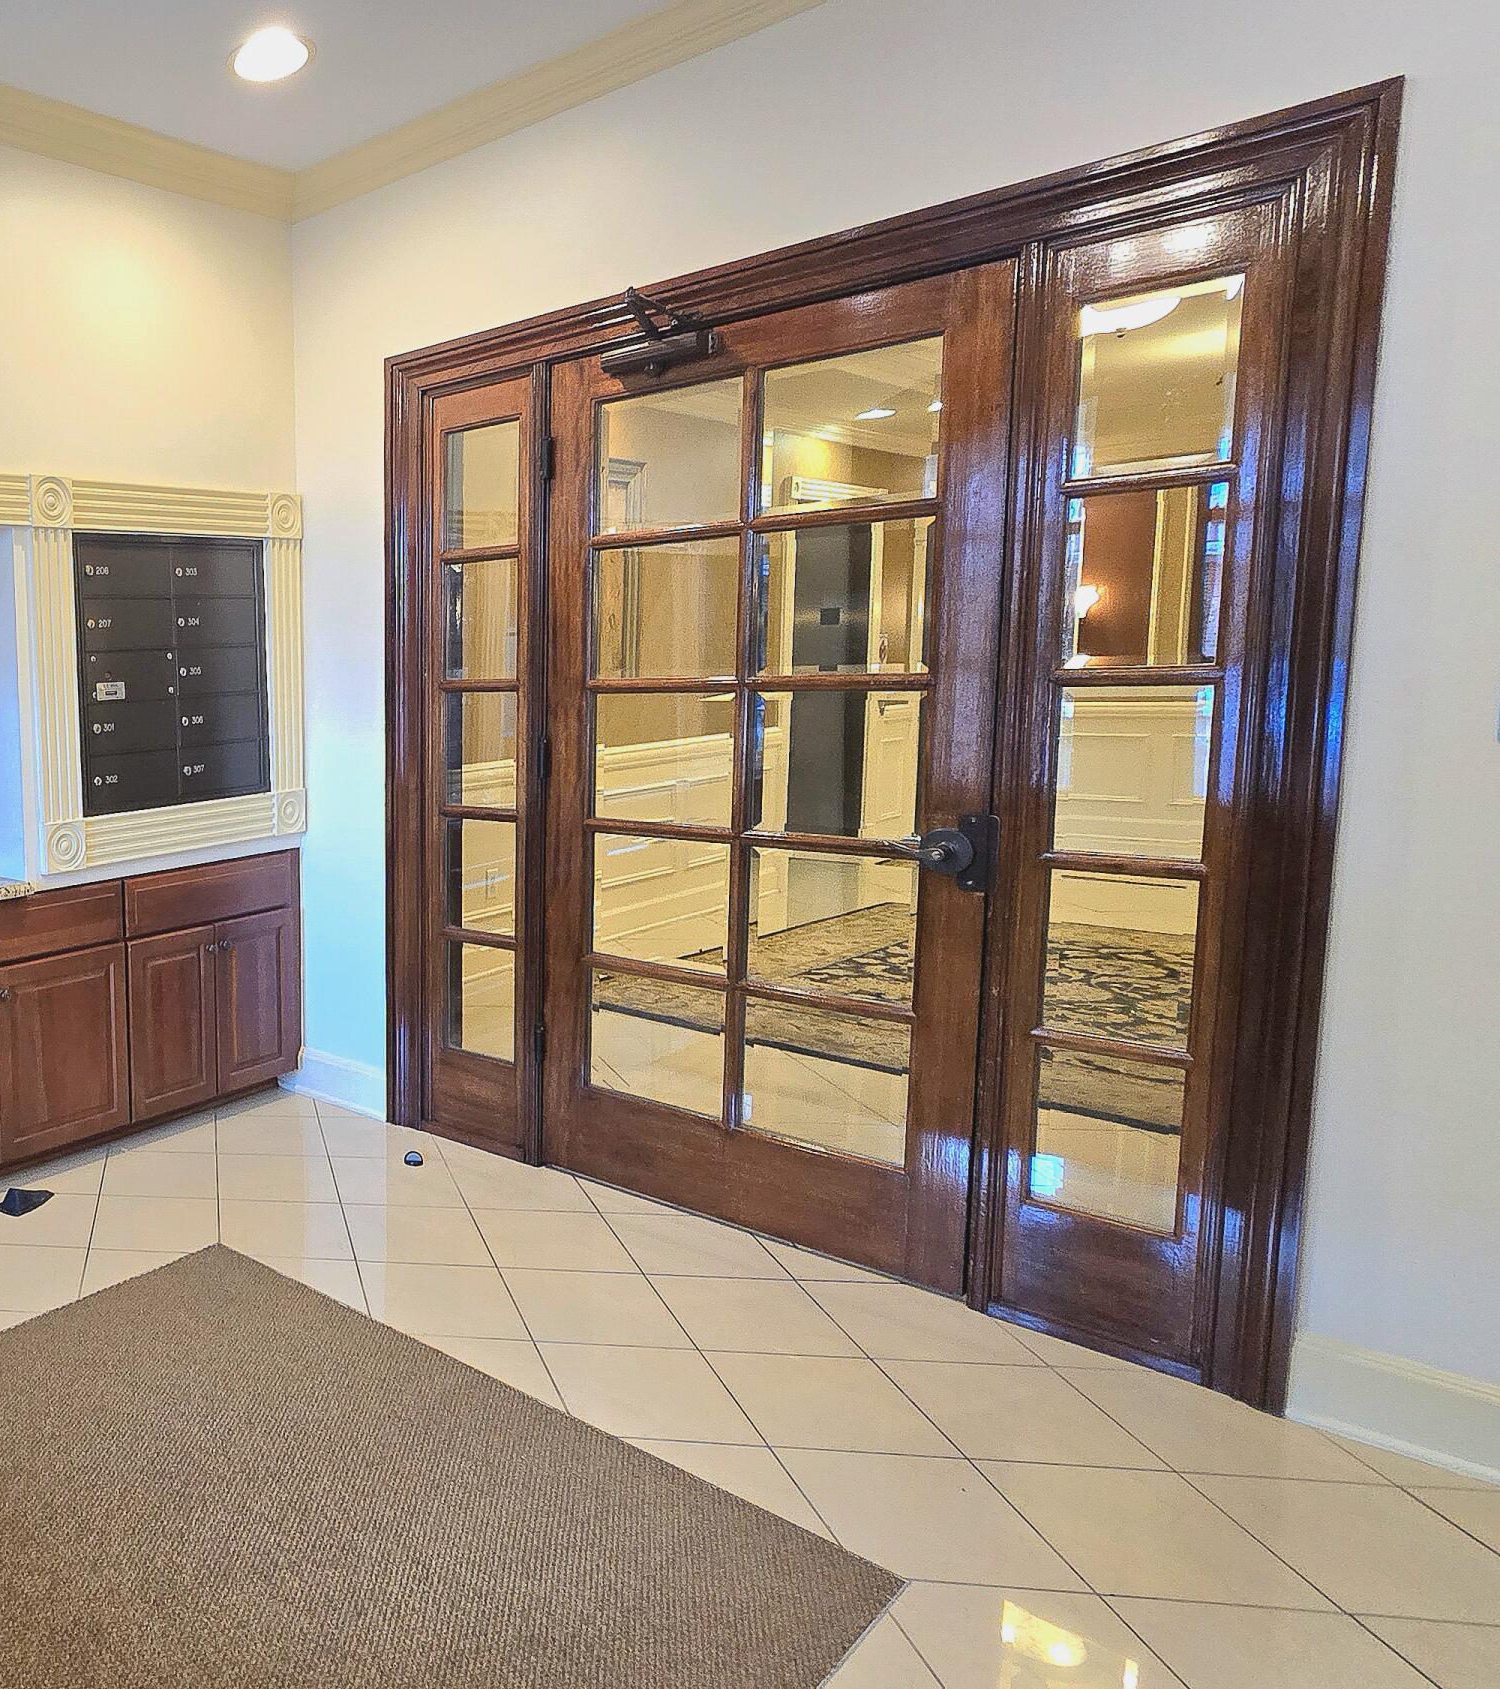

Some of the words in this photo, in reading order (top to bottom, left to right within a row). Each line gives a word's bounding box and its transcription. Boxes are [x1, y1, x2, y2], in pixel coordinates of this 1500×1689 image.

[98, 619, 112, 628] 207
[187, 617, 200, 626] 304
[102, 722, 115, 733] 301
[193, 764, 206, 774] 307
[105, 774, 119, 784] 302
